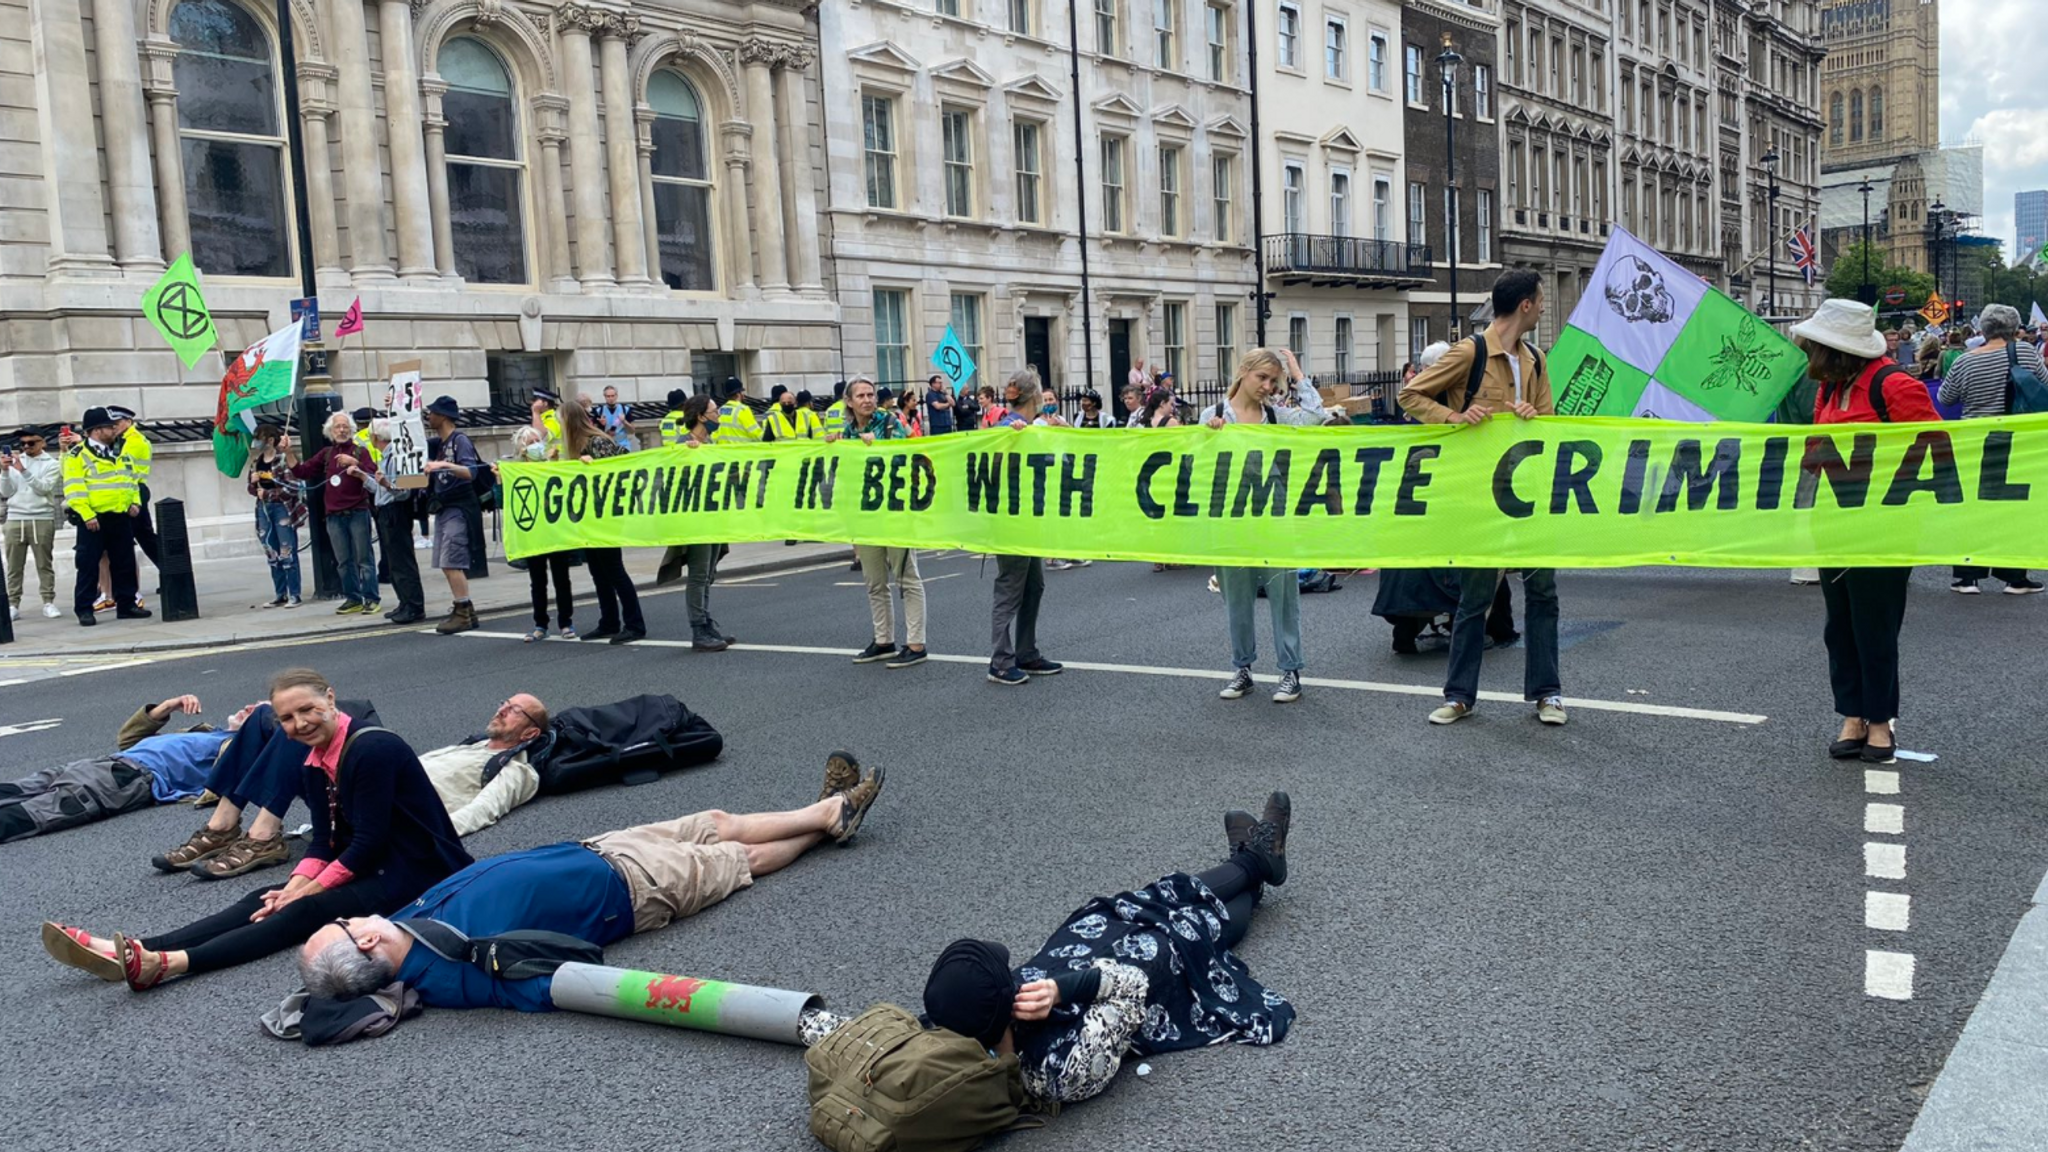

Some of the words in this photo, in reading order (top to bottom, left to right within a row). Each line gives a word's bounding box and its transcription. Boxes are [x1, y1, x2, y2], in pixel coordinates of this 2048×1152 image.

[1557, 365, 1593, 415] tinction
[399, 421, 409, 438] IS
[393, 438, 414, 455] TOO
[394, 451, 424, 475] LATE
[544, 459, 776, 524] GOVERNMENT
[794, 456, 839, 509] IN
[860, 454, 936, 511] BED
[966, 452, 1098, 517] WITH
[1135, 444, 1442, 519] CLIMATE
[1492, 431, 2031, 518] CRIMINAL
